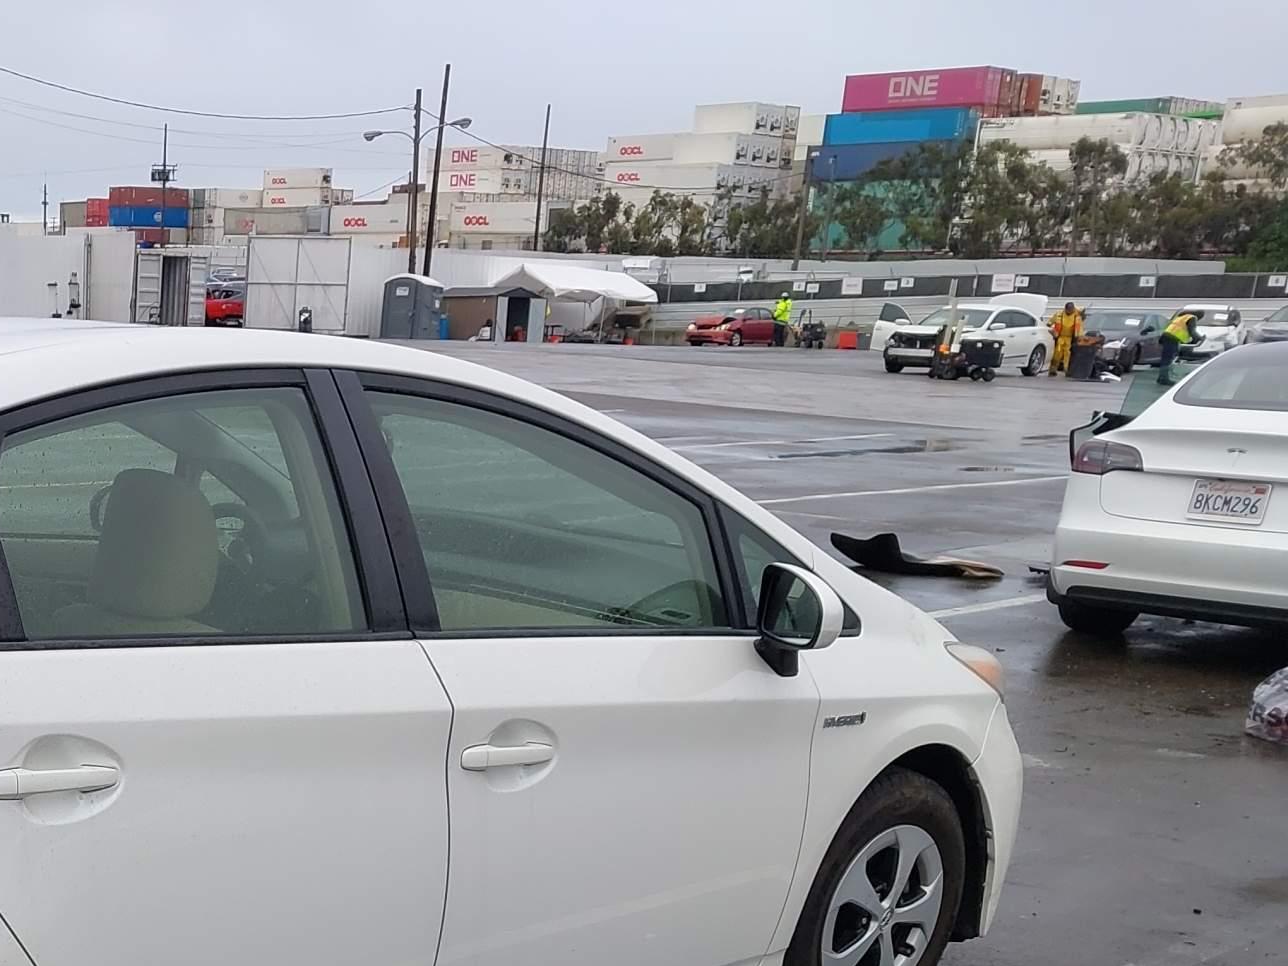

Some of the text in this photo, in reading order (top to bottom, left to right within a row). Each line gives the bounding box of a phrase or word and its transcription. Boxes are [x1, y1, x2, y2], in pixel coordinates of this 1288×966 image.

[888, 75, 939, 97] ONE
[451, 150, 477, 163] ONE
[619, 146, 643, 156] OOCL
[450, 174, 476, 187] ONE
[617, 173, 641, 182] OOCL
[343, 217, 368, 227] OOCL
[464, 216, 489, 226] OOCL
[1193, 493, 1262, 514] 8KCM296
